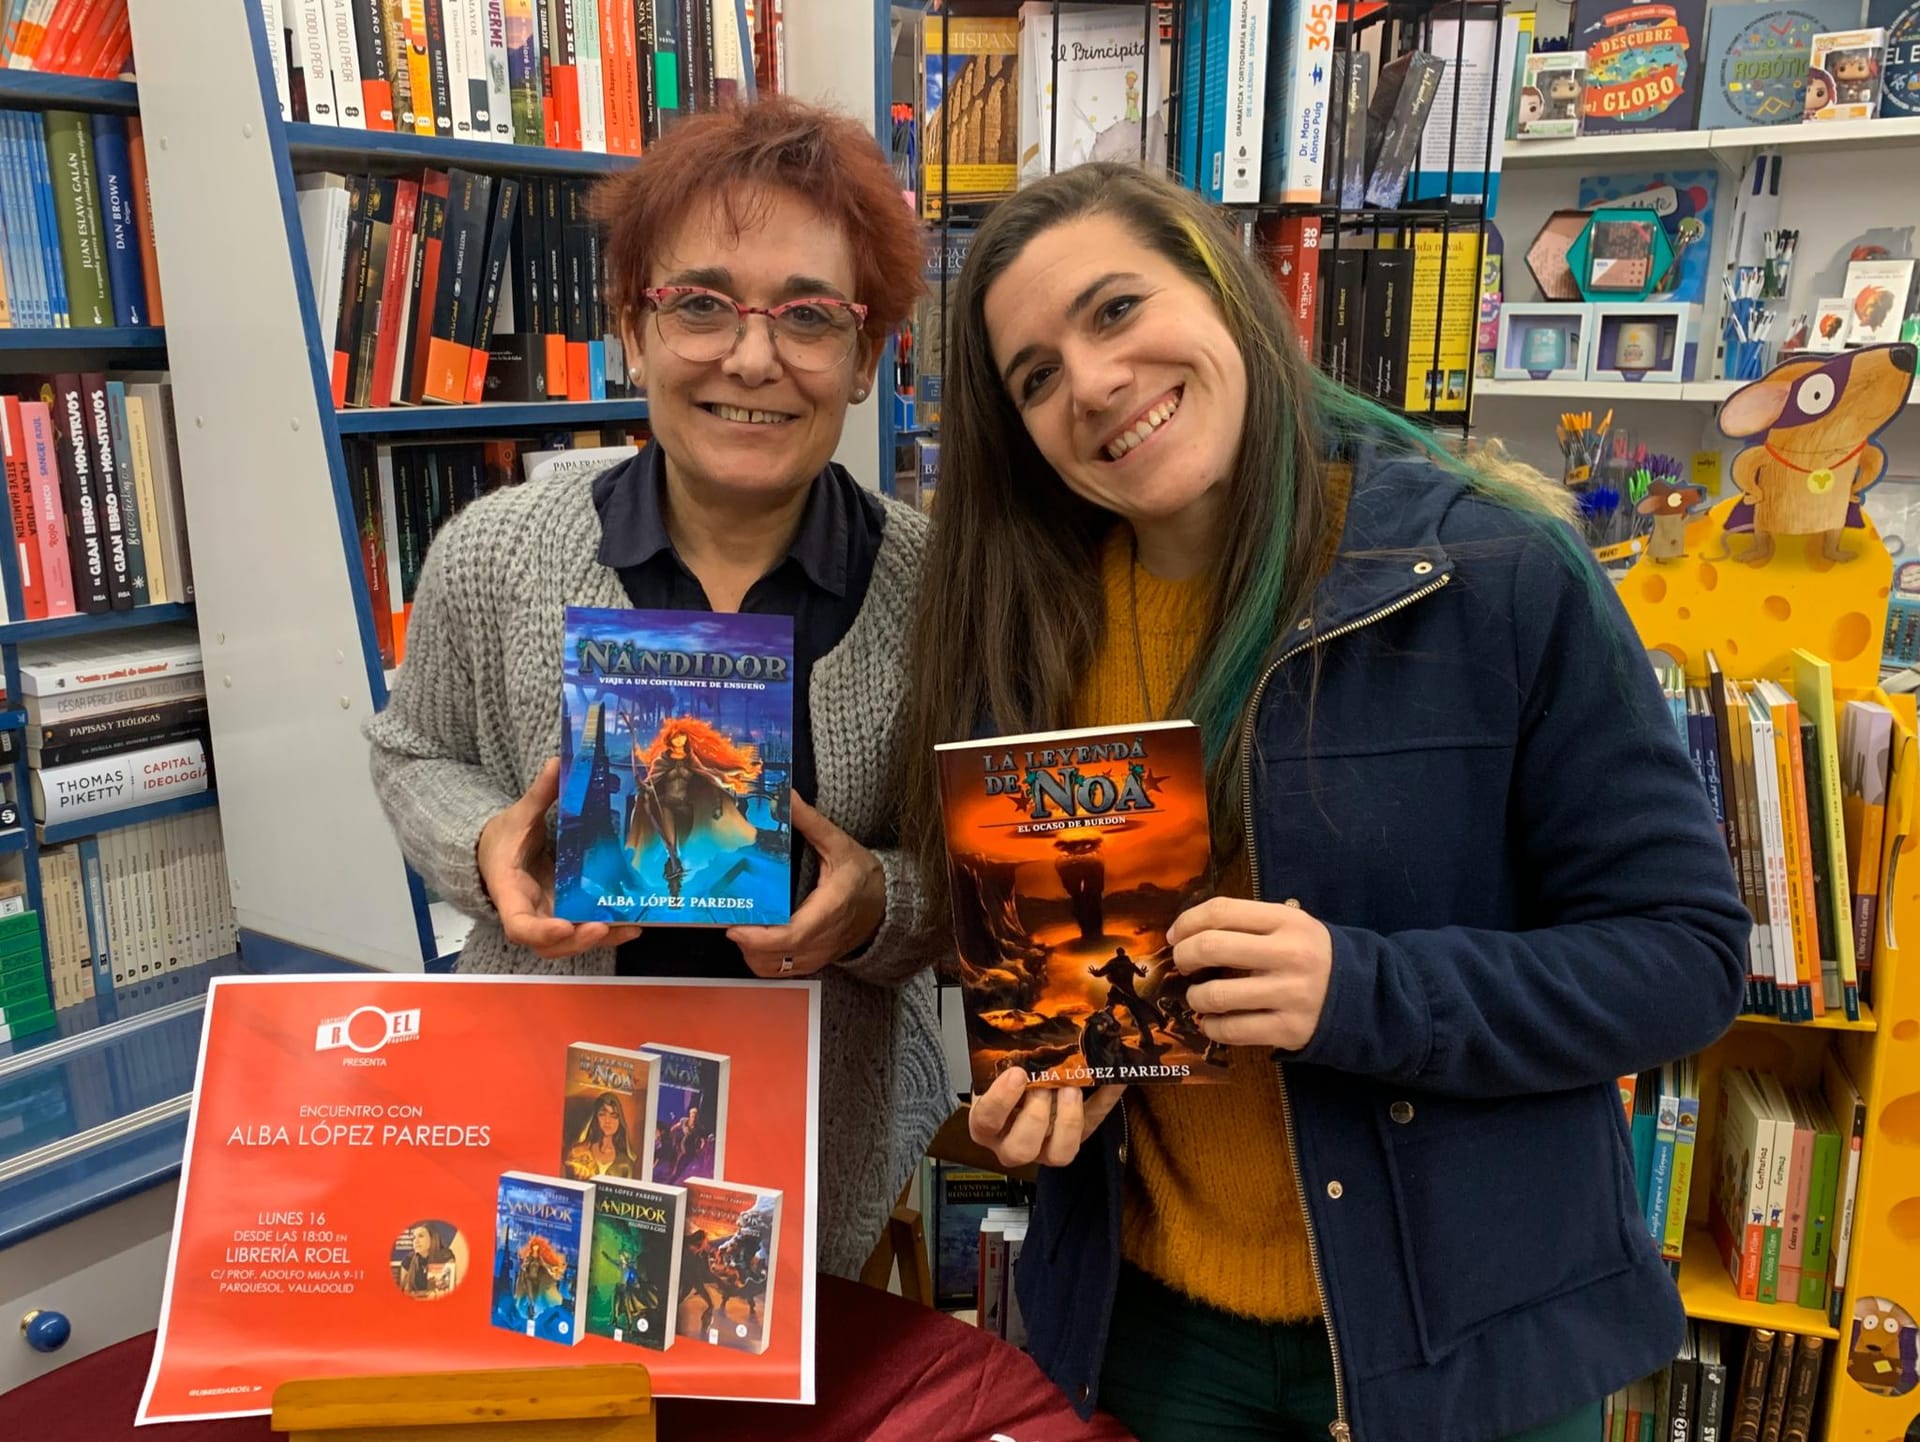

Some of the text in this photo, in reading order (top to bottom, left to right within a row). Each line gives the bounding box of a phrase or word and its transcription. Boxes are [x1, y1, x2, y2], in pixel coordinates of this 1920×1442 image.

[1305, 2, 1332, 51] 365
[374, 40, 382, 54] EN
[1601, 28, 1673, 54] DESCUBRE
[434, 49, 445, 85] HARRIET
[1238, 31, 1246, 83] ORTOGRAFÍA
[1603, 76, 1674, 112] GLOBO
[1235, 92, 1243, 137] GRAMÁTICA
[1299, 107, 1311, 156] Dr. Mario
[1310, 102, 1324, 164] Alonso Puig
[68, 152, 94, 269] JUAN ESLAVA GALÁN
[108, 175, 125, 250] DAN BROWN
[1303, 238, 1317, 248] 20
[1304, 228, 1318, 238] 20
[1300, 272, 1311, 320] MICHELIN
[19, 461, 30, 493] PLAN
[6, 461, 22, 539] STEVE HAMILTON
[106, 493, 121, 533] LIBRO
[80, 495, 96, 533] LIBRO
[85, 536, 102, 576] GRAN
[111, 534, 127, 574] GRAN
[599, 677, 766, 691] VIAJE A UN CONTINENTE DE ENSUEÑO
[69, 713, 161, 737] PAPISAS Y TEÓLOGAS
[143, 756, 195, 776] CAPITAL
[983, 738, 1146, 773] LA LEYENDA
[57, 770, 124, 794] THOMAS
[984, 765, 1154, 819] DE NOA
[60, 785, 124, 808] PIKETTY
[1017, 815, 1126, 833] EL OCASO DE BURDON
[597, 892, 754, 909] ALBA LÓPEZ PAREDES
[1860, 897, 1870, 918] cama
[1855, 936, 1867, 960] Cinco
[343, 1057, 387, 1067] PRESENTA
[1065, 1064, 1114, 1081] LÓPEZ
[1119, 1064, 1190, 1078] PAREDES
[592, 1064, 634, 1091] NOA
[300, 1105, 423, 1118] ENCUENTRO CON
[227, 1120, 491, 1147] ALBA LÓPEZ PAREDES
[1754, 1147, 1768, 1190] Contrarios
[258, 1212, 326, 1226] LUNES 16
[233, 1230, 273, 1243] DESDE
[275, 1230, 298, 1243] LAS
[301, 1230, 333, 1243] 18:00
[225, 1245, 351, 1264] LIBRERÍA ROEL
[211, 1269, 365, 1280] C/ PROF. ADOLFO MIAJA 9-11
[288, 1282, 354, 1294] VALLADOLID
